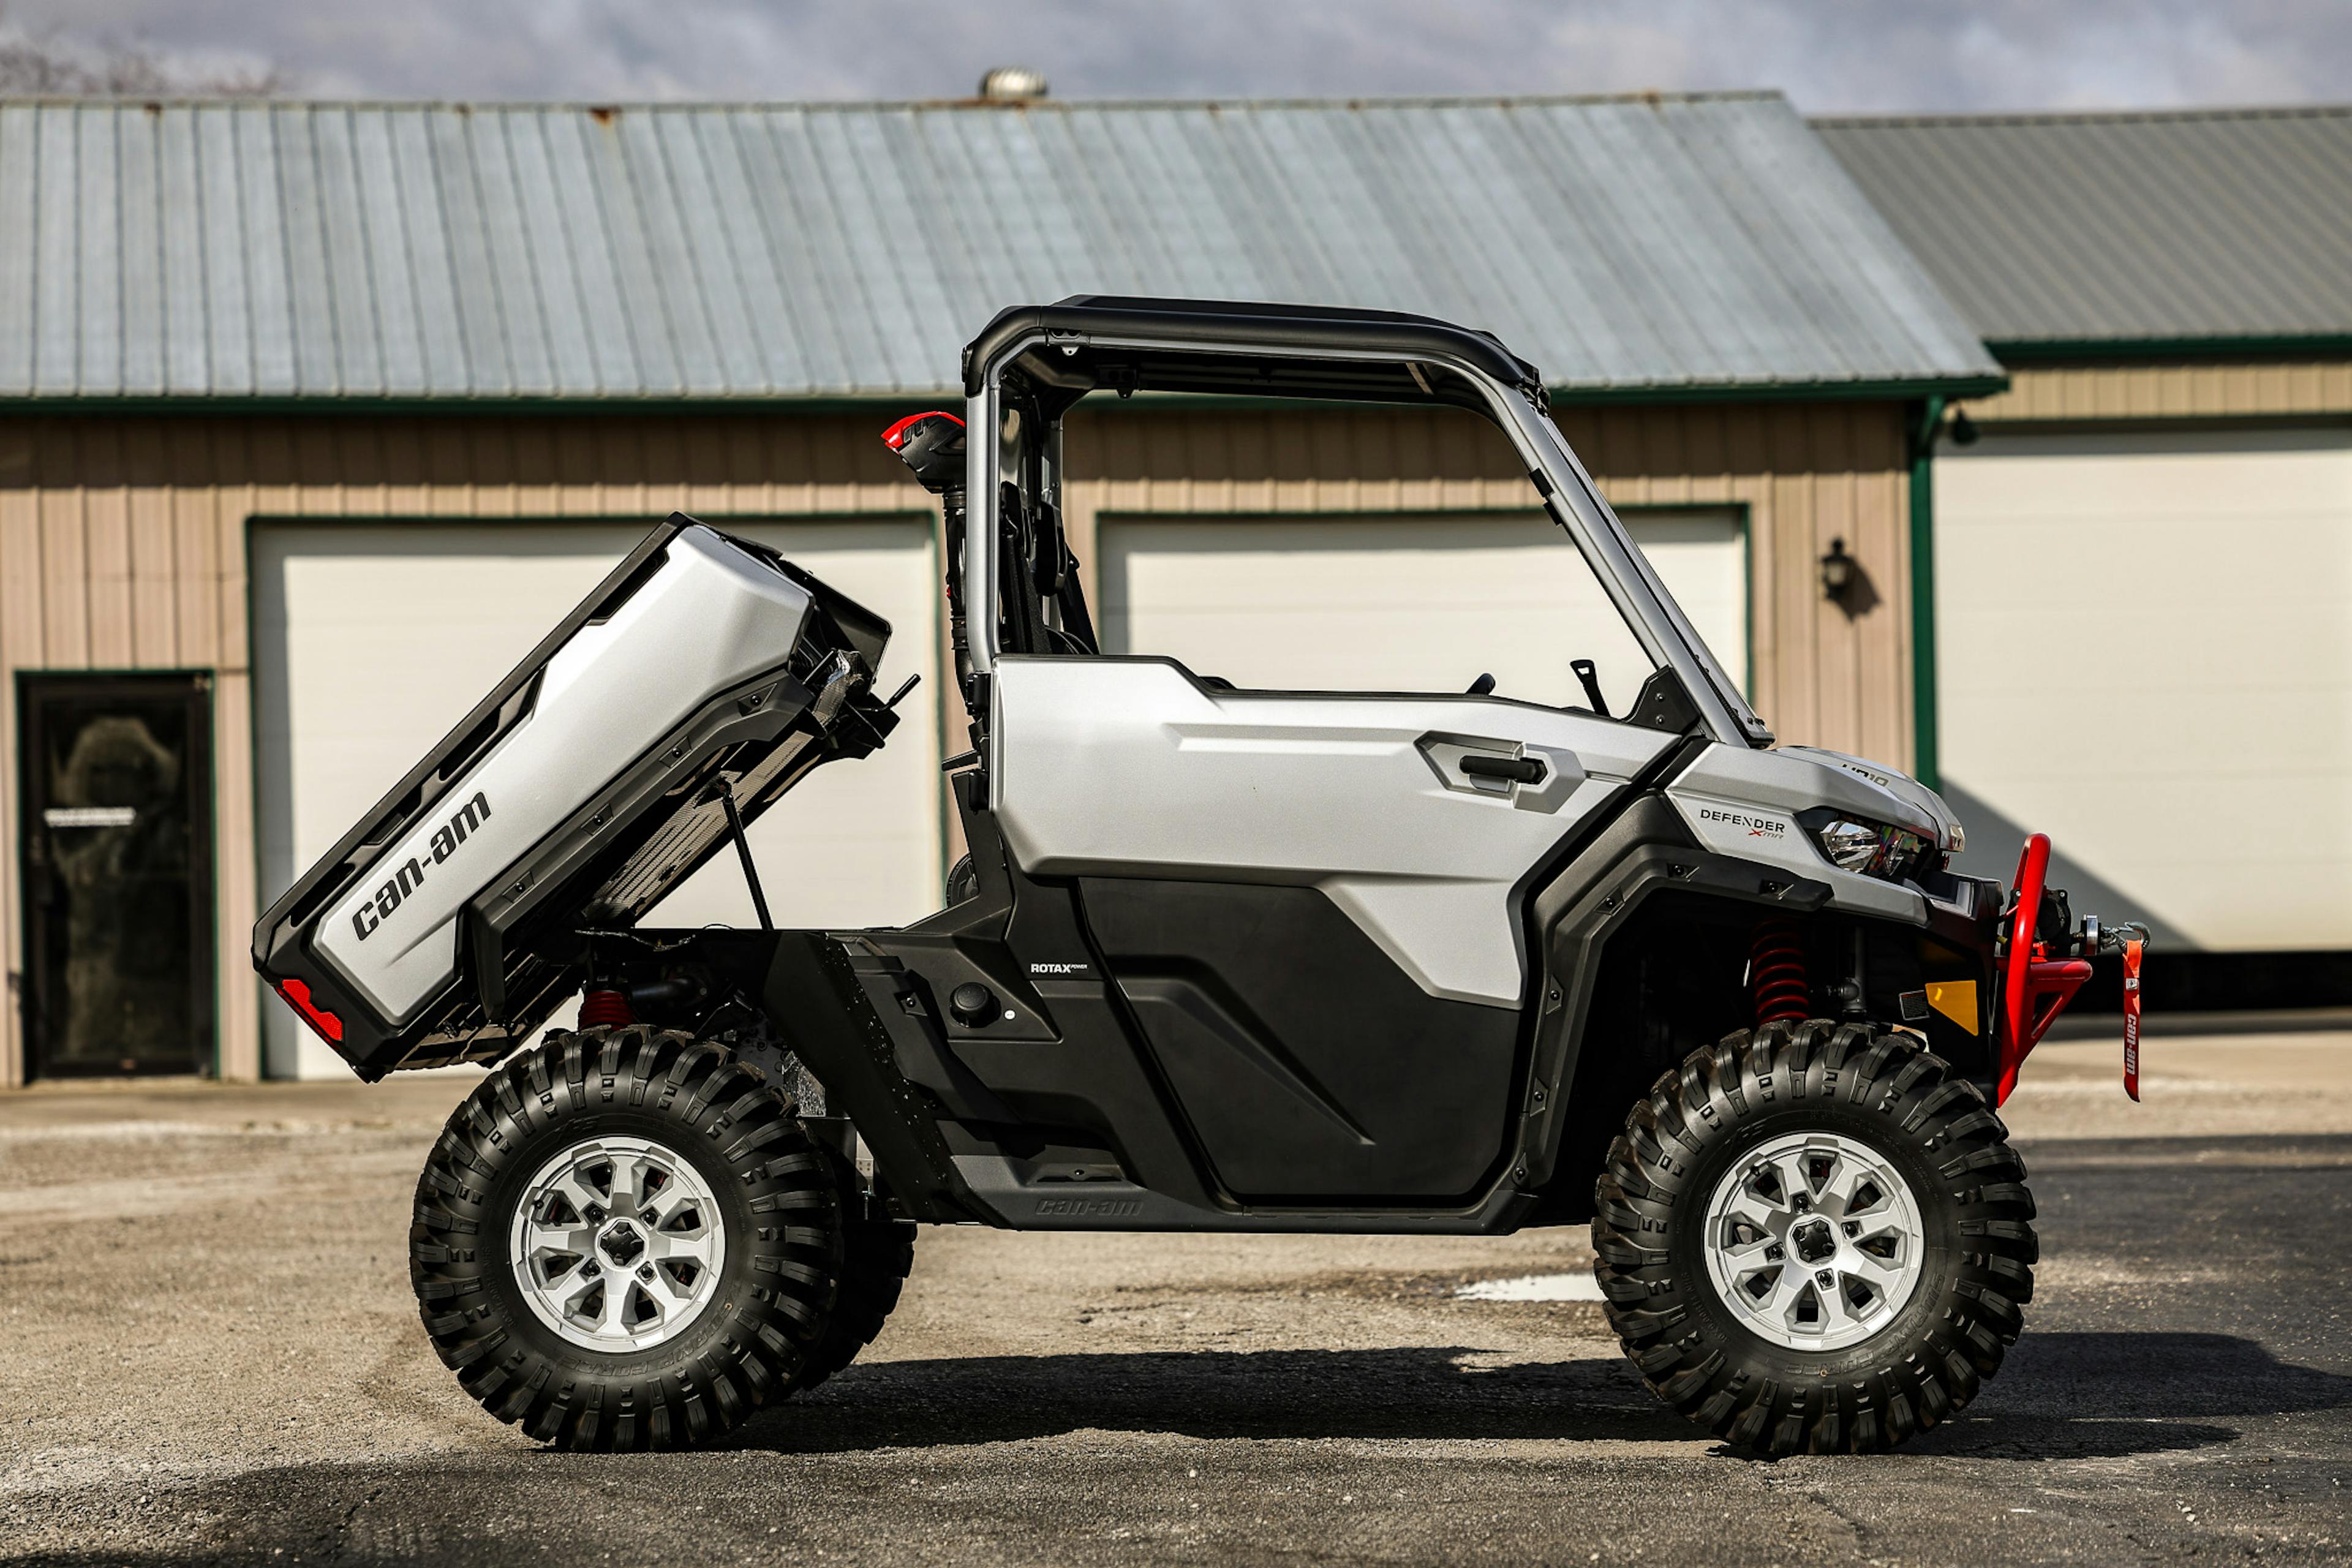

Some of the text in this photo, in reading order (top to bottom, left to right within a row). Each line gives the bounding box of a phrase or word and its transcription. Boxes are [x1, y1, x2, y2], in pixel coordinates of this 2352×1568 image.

[1700, 809, 1785, 833] DEFENDER
[352, 791, 492, 941] can-am
[1031, 963, 1071, 973] ROTAX
[2126, 1013, 2137, 1076] can-am
[1035, 1199, 1144, 1216] can-am
